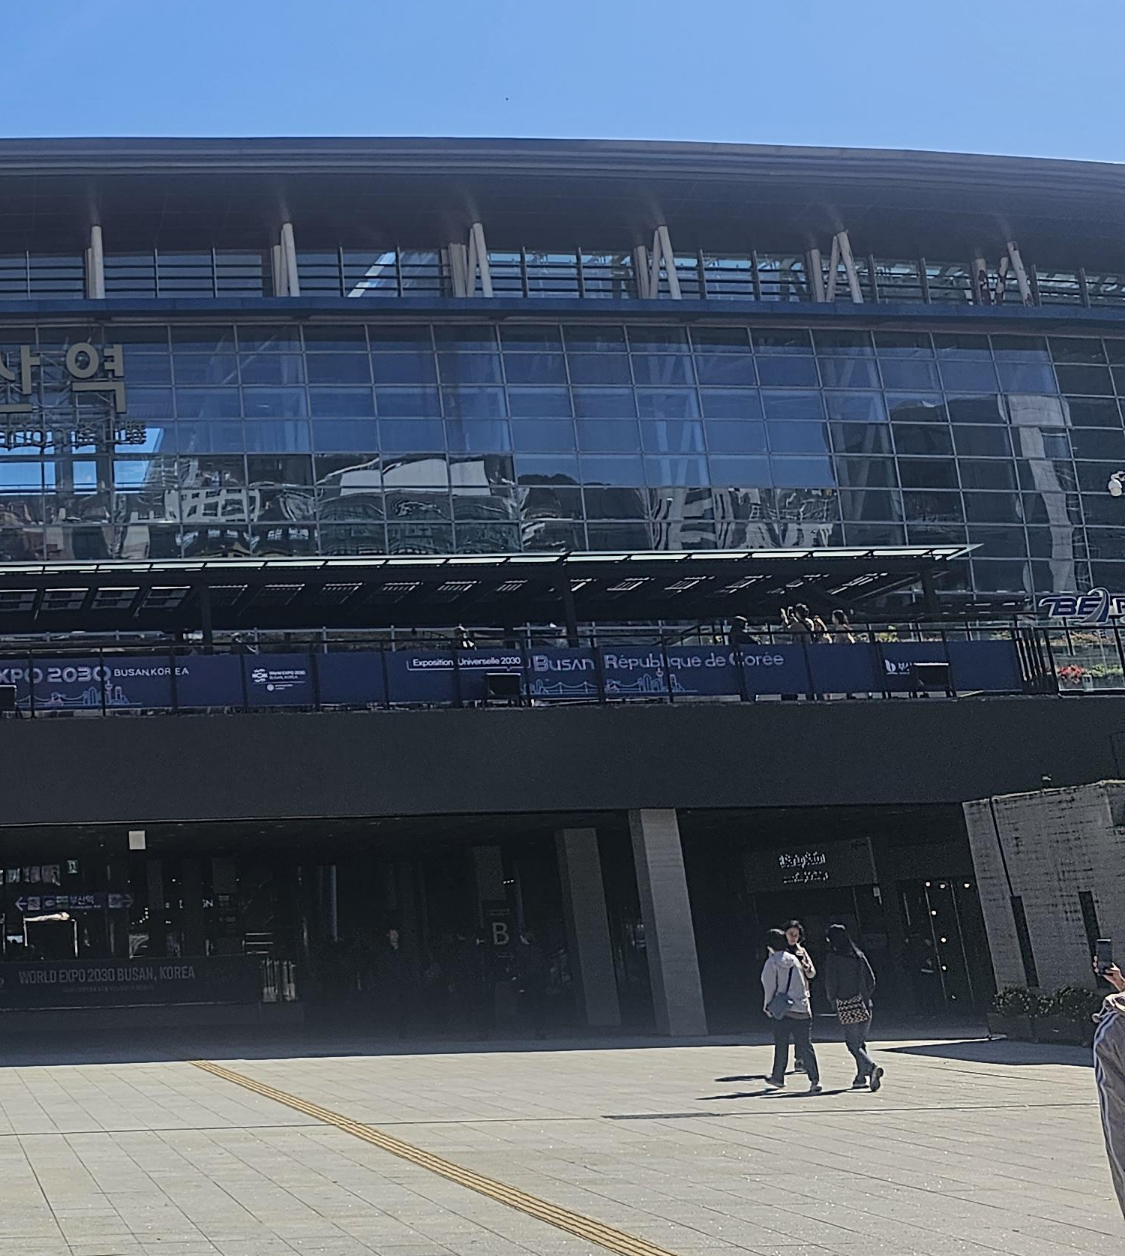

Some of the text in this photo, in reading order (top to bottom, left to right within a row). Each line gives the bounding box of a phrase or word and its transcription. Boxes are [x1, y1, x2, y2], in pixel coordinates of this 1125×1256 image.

[412, 656, 521, 668] Exposition Universelle 2030
[705, 653, 726, 667] de
[47, 666, 111, 683] 2030
[492, 922, 510, 946] B
[18, 965, 196, 985] WORLD EXPO 2030 BUSAN, KOREA
